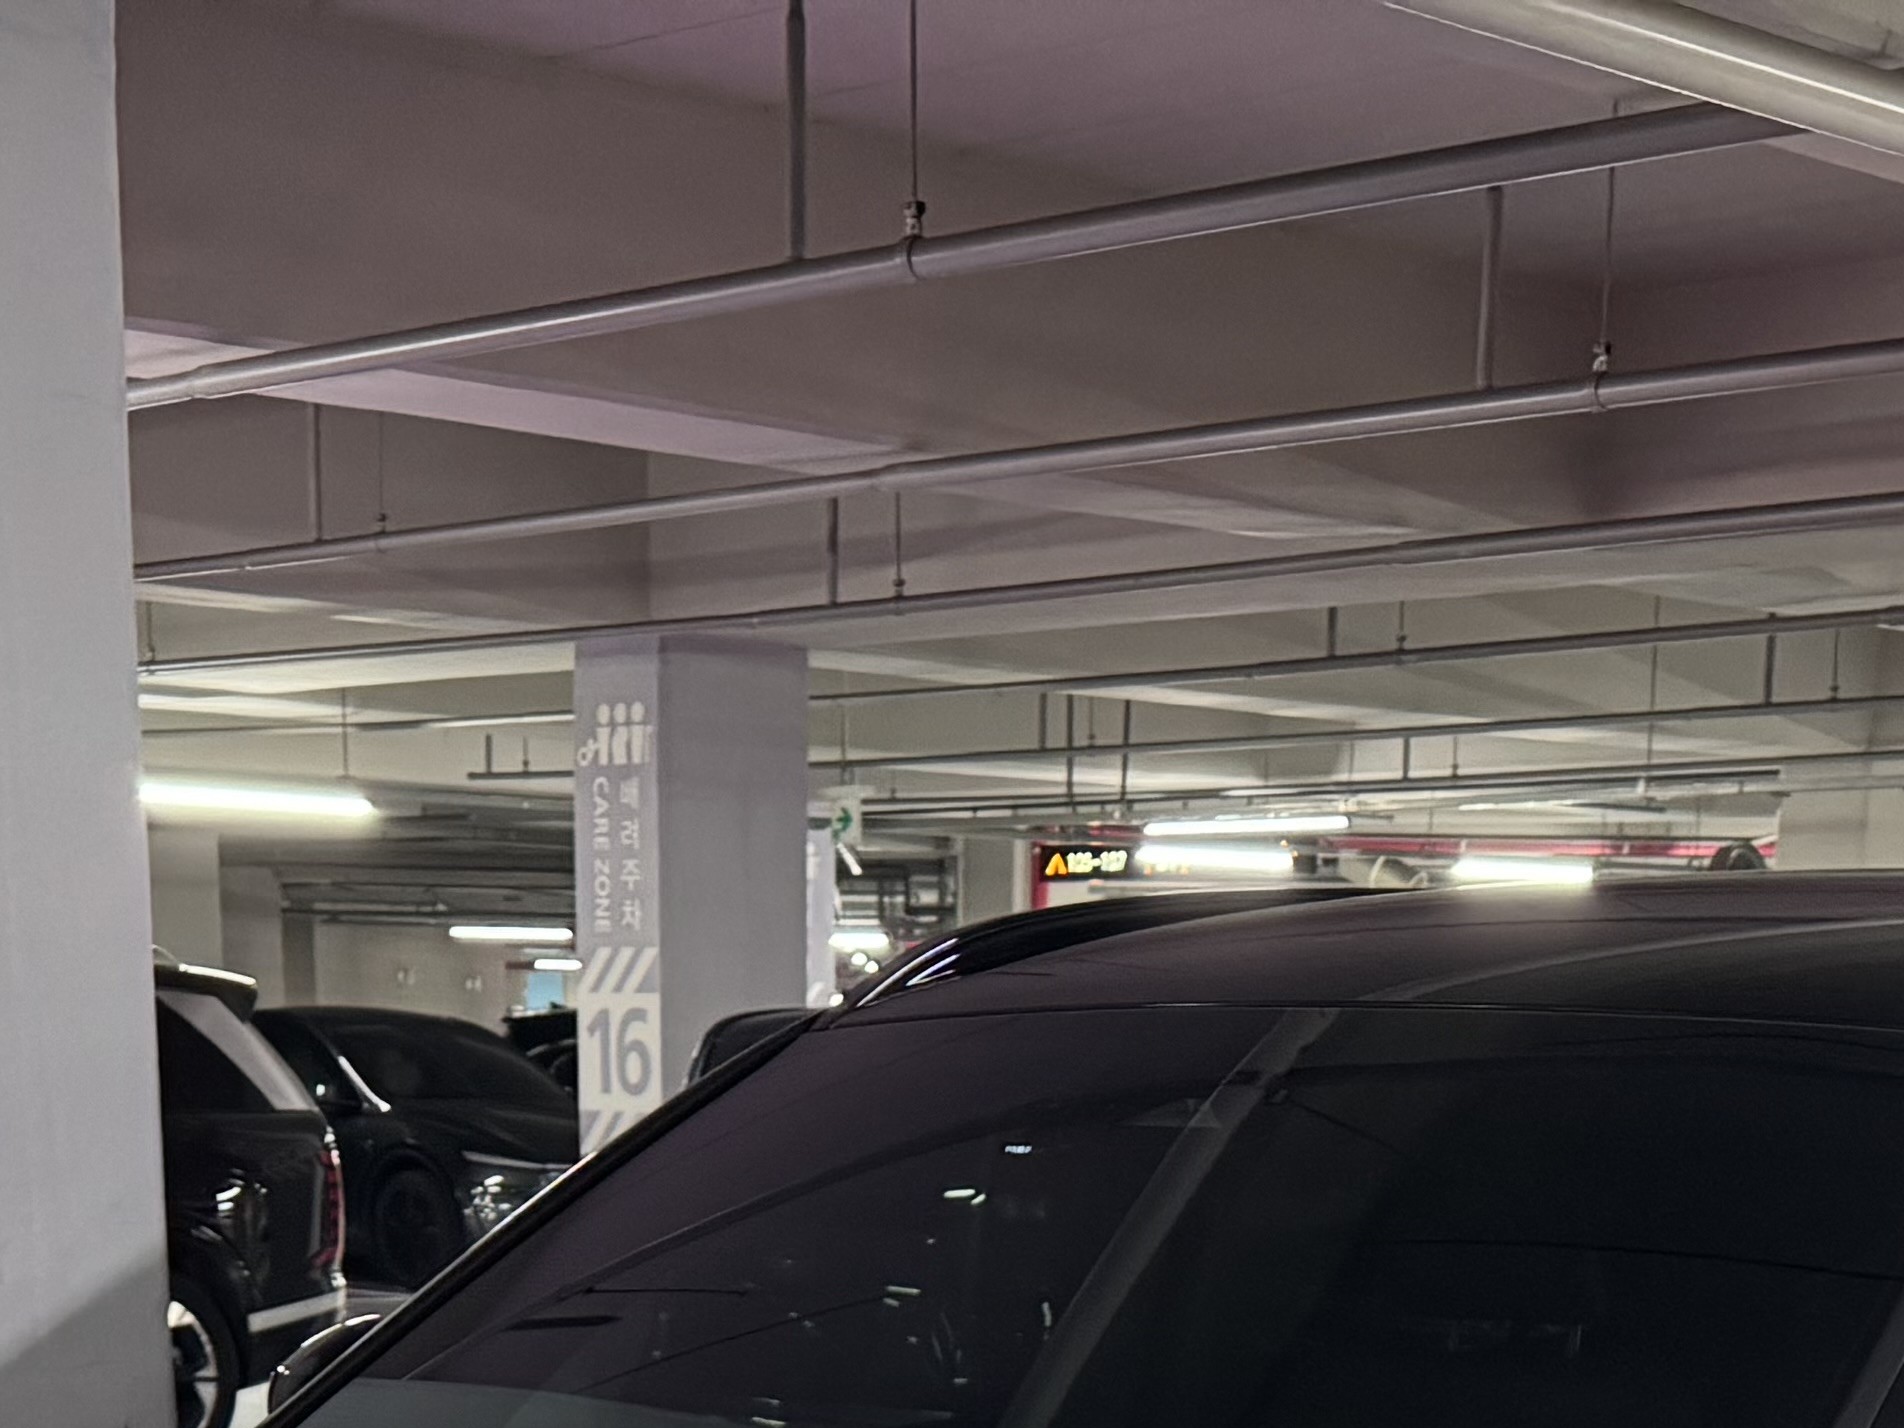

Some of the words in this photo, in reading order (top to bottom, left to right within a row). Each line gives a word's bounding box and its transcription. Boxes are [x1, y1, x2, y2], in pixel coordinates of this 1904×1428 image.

[593, 776, 611, 850] CARE
[594, 858, 612, 933] ZONE
[587, 1008, 652, 1096] 16
